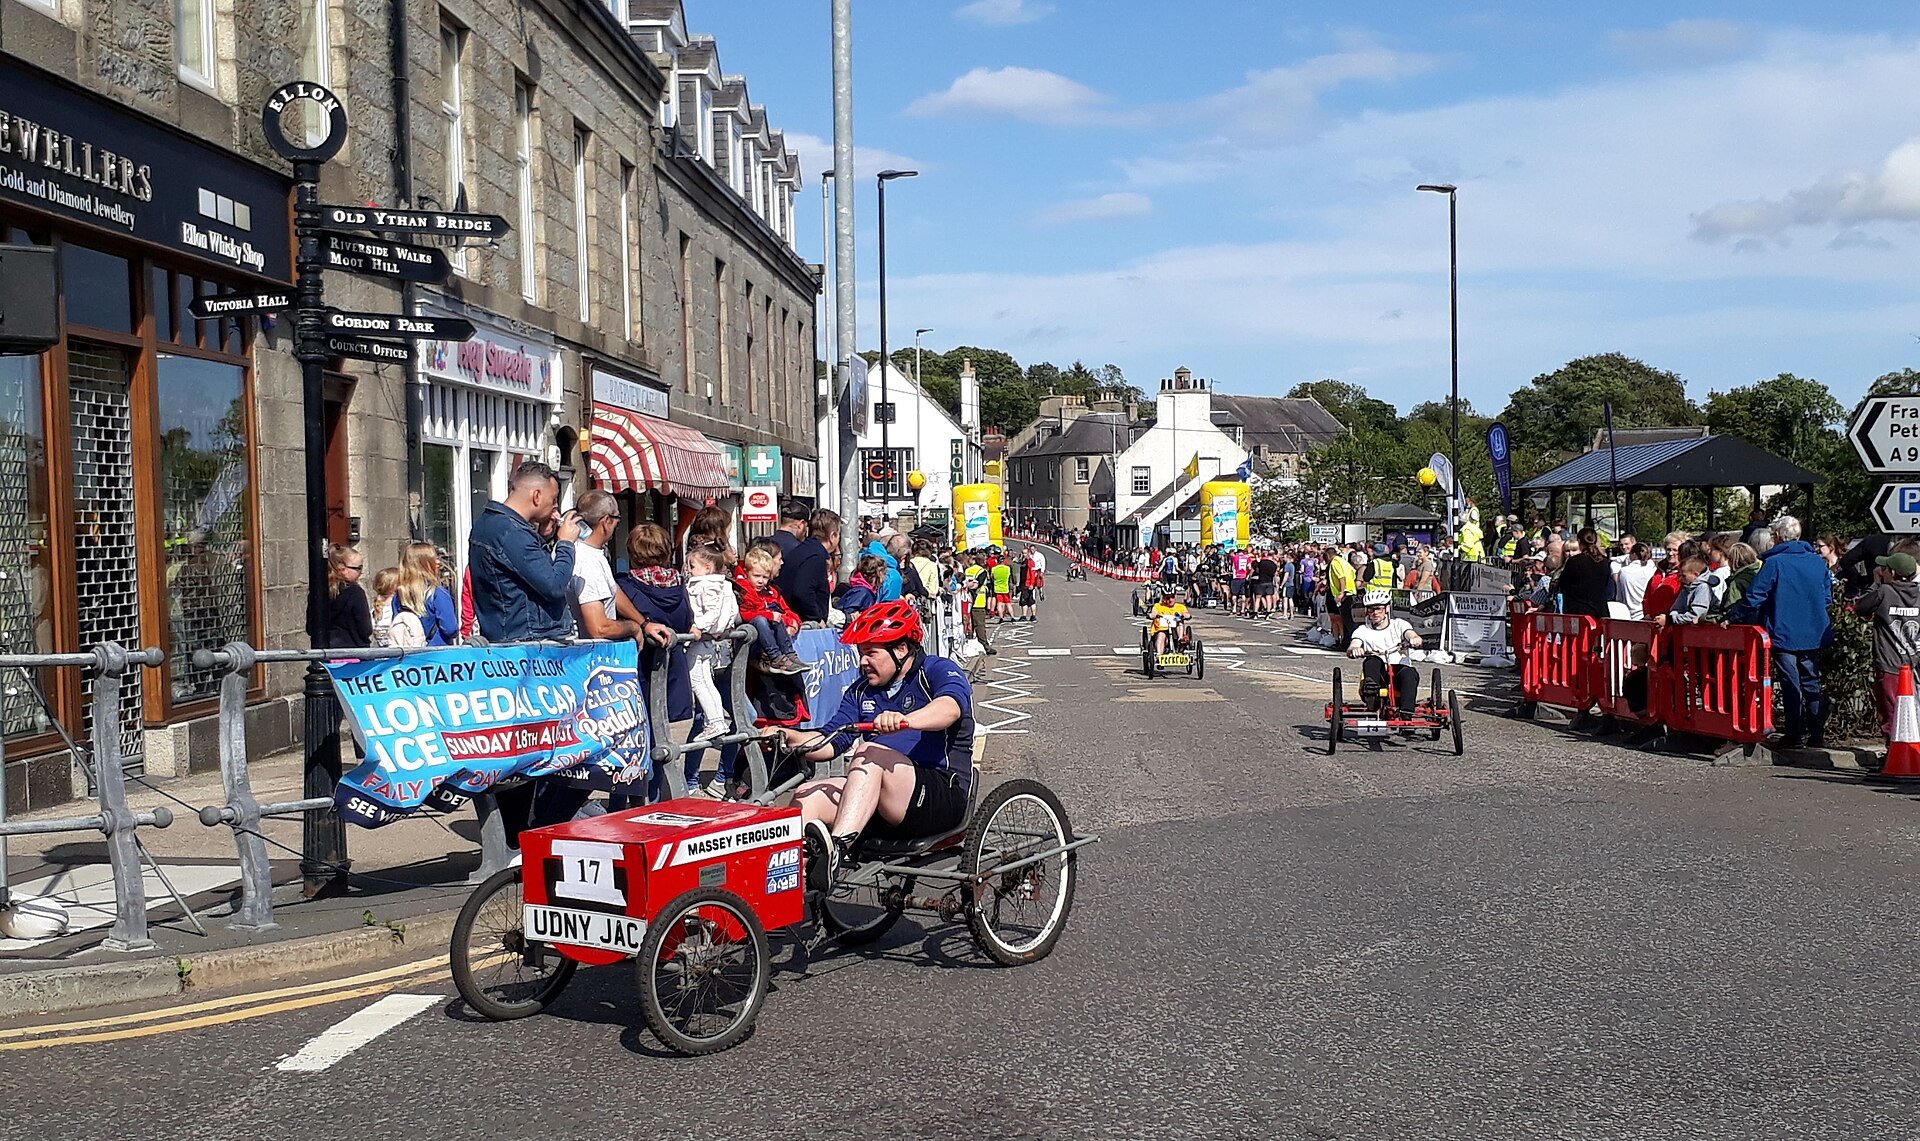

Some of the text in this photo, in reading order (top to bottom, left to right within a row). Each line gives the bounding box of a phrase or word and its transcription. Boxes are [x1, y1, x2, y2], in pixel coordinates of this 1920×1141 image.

[269, 84, 339, 113] ELLON
[0, 165, 136, 231] Gold and Diamond Jewellery
[333, 210, 492, 231] OLD YTHAN BRIDGE
[182, 221, 265, 272] Ellon Whisky Shop
[330, 236, 432, 264] RIVERSIDE WALKS
[330, 252, 400, 274] MOOT HILL
[205, 295, 289, 312] VICTORIA HALL
[332, 314, 435, 333] GORDON PARK
[329, 338, 408, 359] COUNCIL OFFICES
[342, 673, 388, 695] THE
[391, 662, 476, 688] ROTARY
[481, 660, 519, 678] CLUB
[532, 659, 566, 676] ELLON
[598, 673, 614, 685] The
[365, 684, 576, 737] LON PEDAL CAR
[445, 731, 513, 756] SUNDAY
[515, 729, 539, 749] 18TH
[347, 797, 379, 819] SEE
[688, 825, 790, 856] MASSEY FERGUSON
[768, 848, 799, 869] AMB
[578, 859, 600, 885] 17
[534, 909, 640, 949] UDNY JAC
